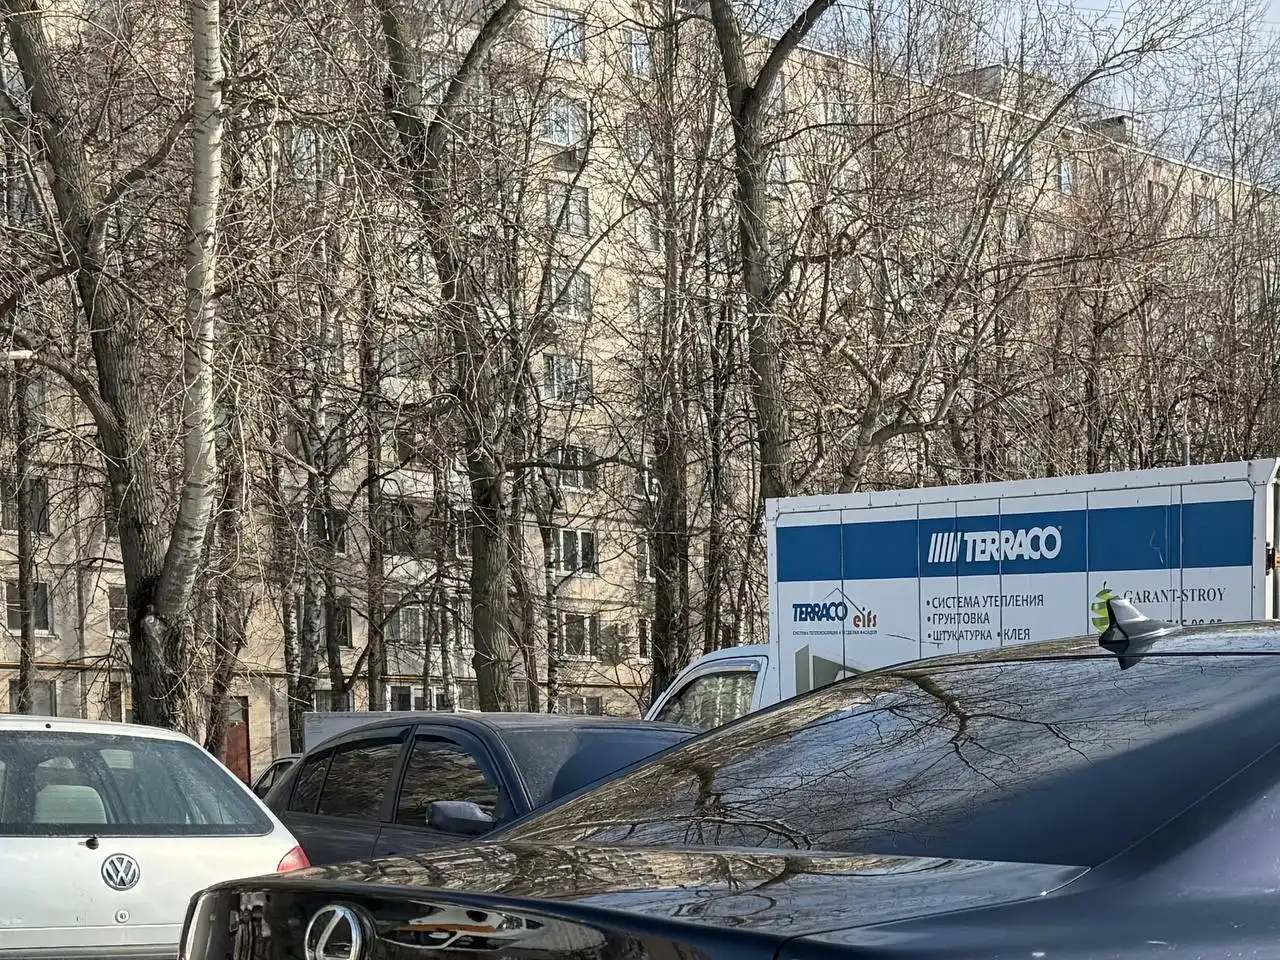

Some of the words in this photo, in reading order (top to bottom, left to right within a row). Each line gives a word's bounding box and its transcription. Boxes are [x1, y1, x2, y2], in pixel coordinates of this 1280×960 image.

[964, 525, 1062, 562] TERRACO
[931, 596, 980, 609] СИСТЕМА
[982, 594, 1044, 608] УТЕПЛЕНИЯ
[1123, 587, 1226, 604] GARANT-STROY
[792, 602, 848, 622] TERRACO
[932, 612, 990, 625] ГРУНТОВКА
[933, 629, 993, 641] ШТУКАТУРКА
[1003, 628, 1031, 641] КЛЕЯ
